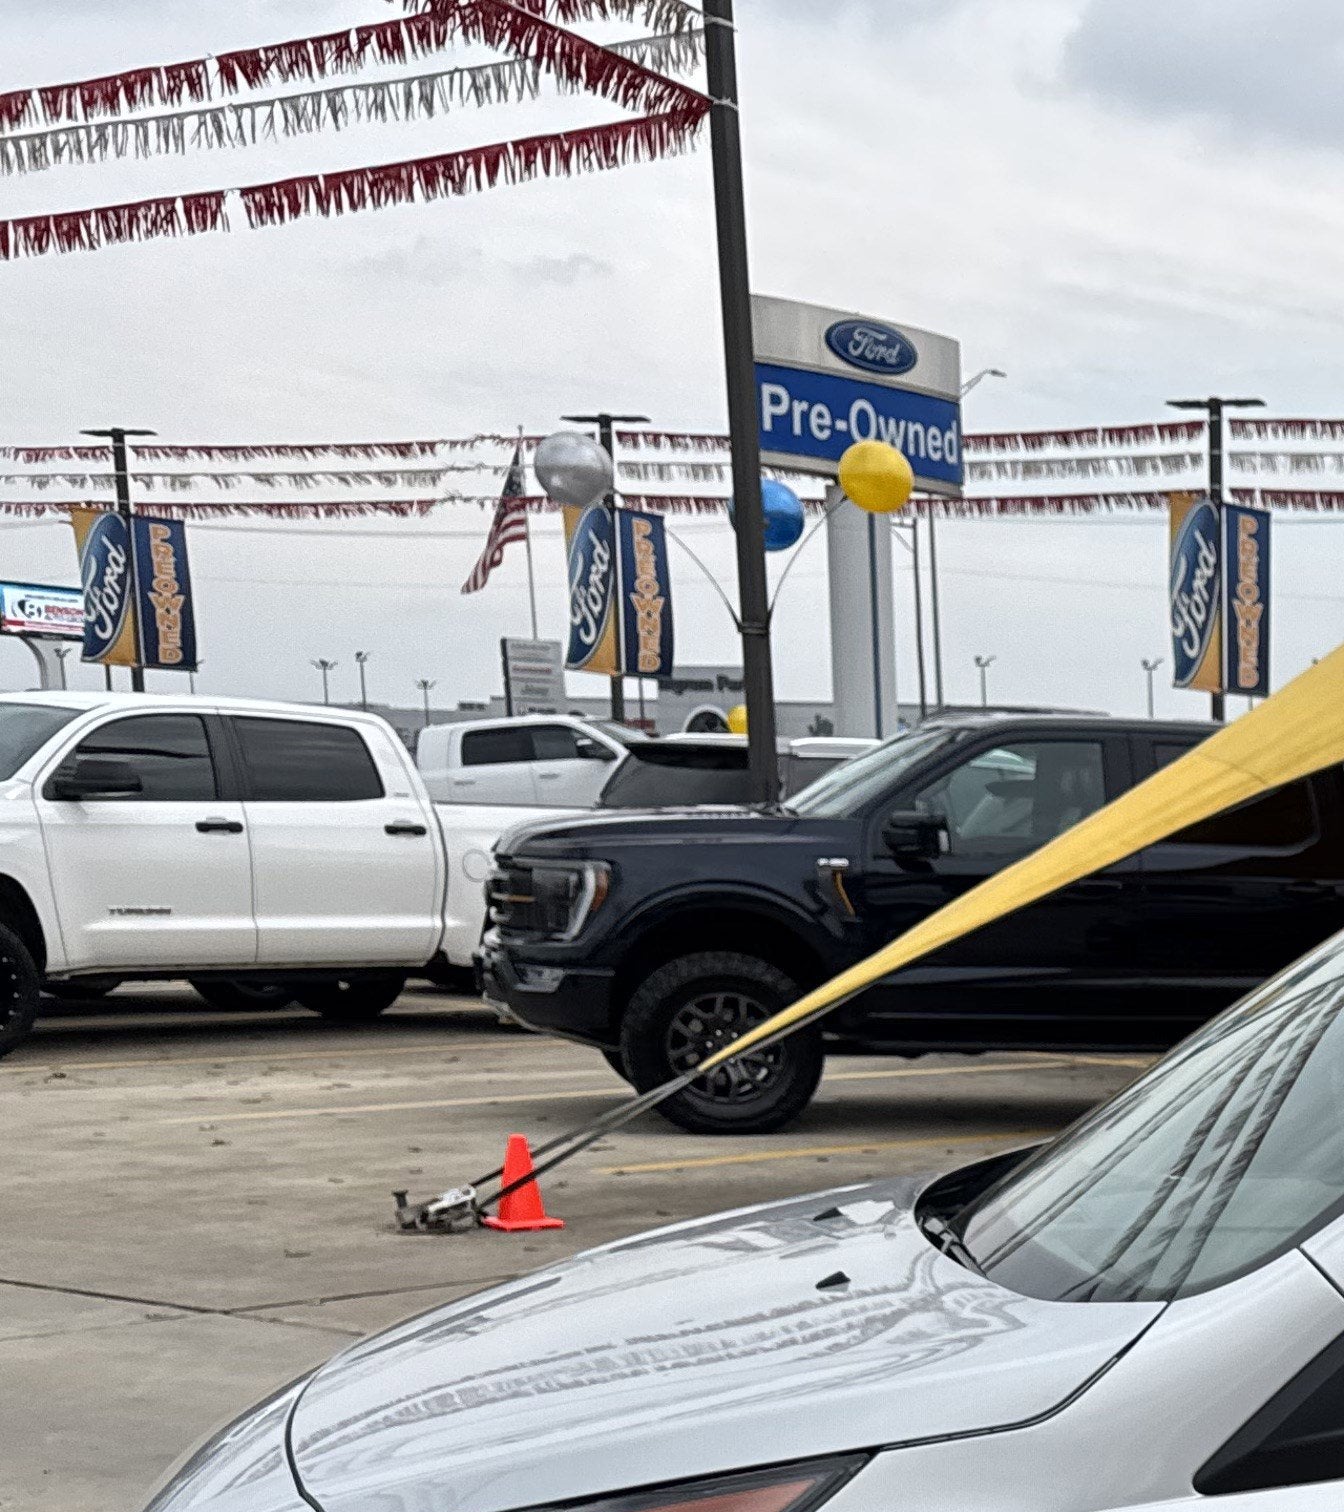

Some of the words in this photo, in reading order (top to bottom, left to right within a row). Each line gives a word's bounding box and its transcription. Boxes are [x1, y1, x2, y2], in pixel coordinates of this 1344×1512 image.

[848, 326, 901, 365] Ford
[761, 382, 959, 465] Pre-Owned
[84, 534, 128, 640] Ford
[570, 529, 611, 645] Ford
[1171, 529, 1218, 658] Ford
